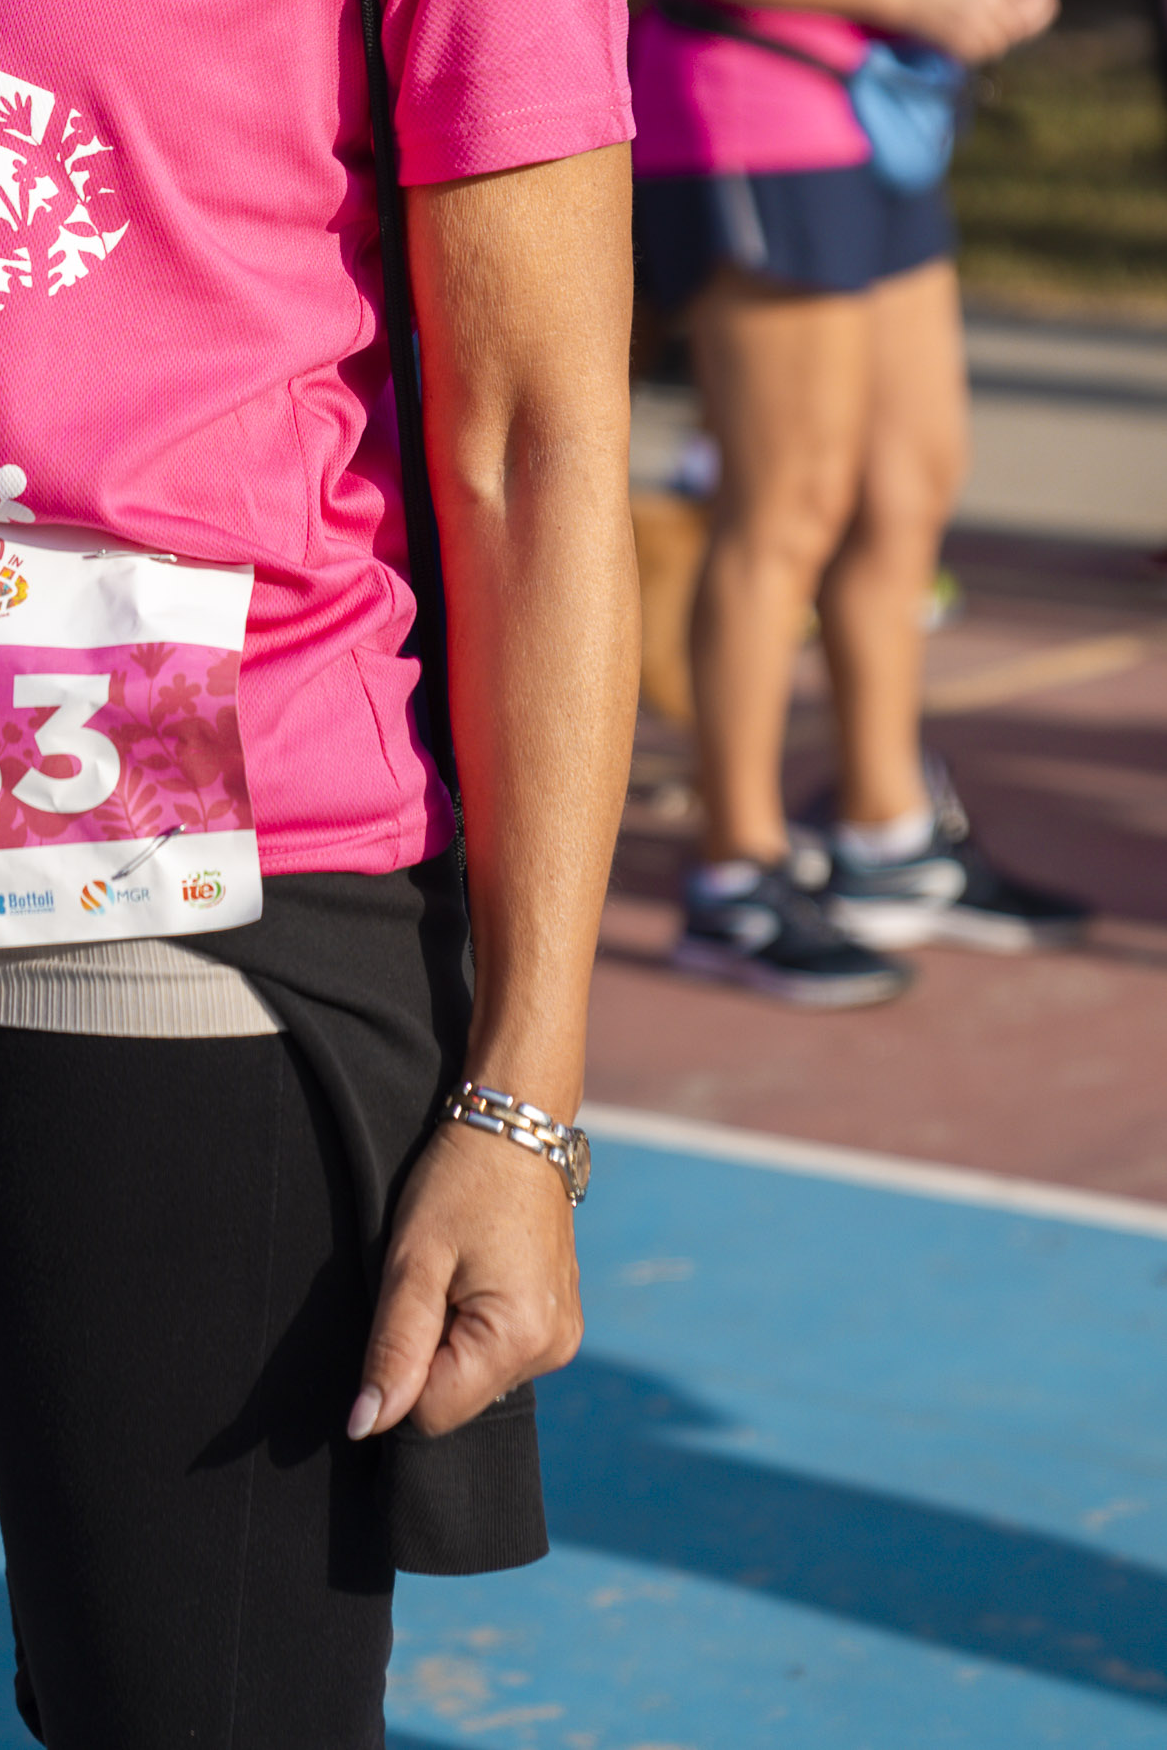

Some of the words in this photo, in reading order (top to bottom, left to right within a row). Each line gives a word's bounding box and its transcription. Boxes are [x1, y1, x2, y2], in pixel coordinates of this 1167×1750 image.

[8, 554, 24, 568] IN
[8, 891, 54, 908] Bottoli
[116, 888, 151, 902] MGR
